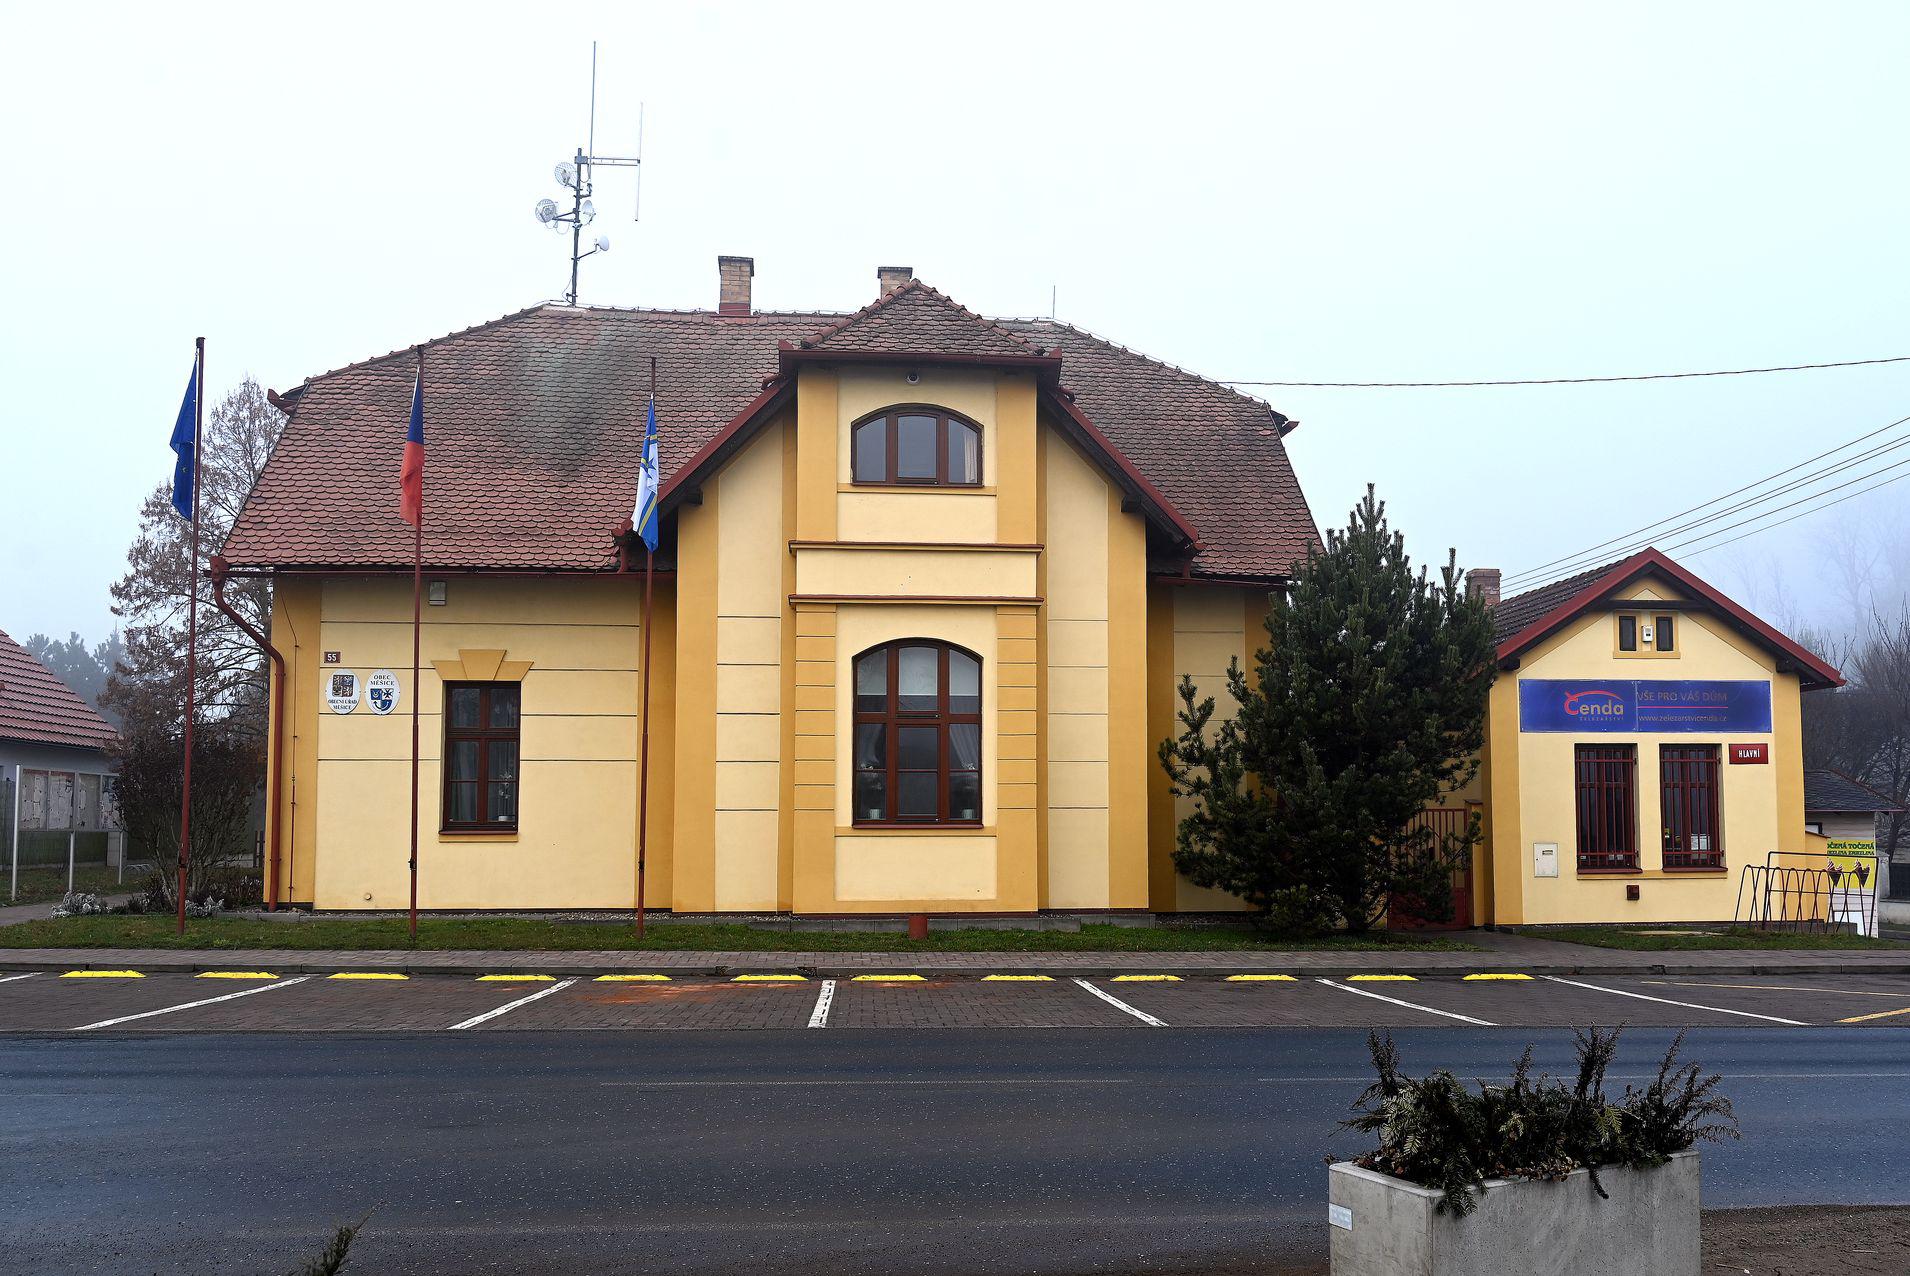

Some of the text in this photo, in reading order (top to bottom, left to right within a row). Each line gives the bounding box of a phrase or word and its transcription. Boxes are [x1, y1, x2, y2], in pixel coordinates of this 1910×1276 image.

[327, 653, 337, 661] 55
[1637, 689, 1655, 701] VŠE
[1657, 691, 1678, 701] PRO
[1564, 690, 1624, 715] Čenda
[1738, 748, 1760, 758] HLAVNÍ
